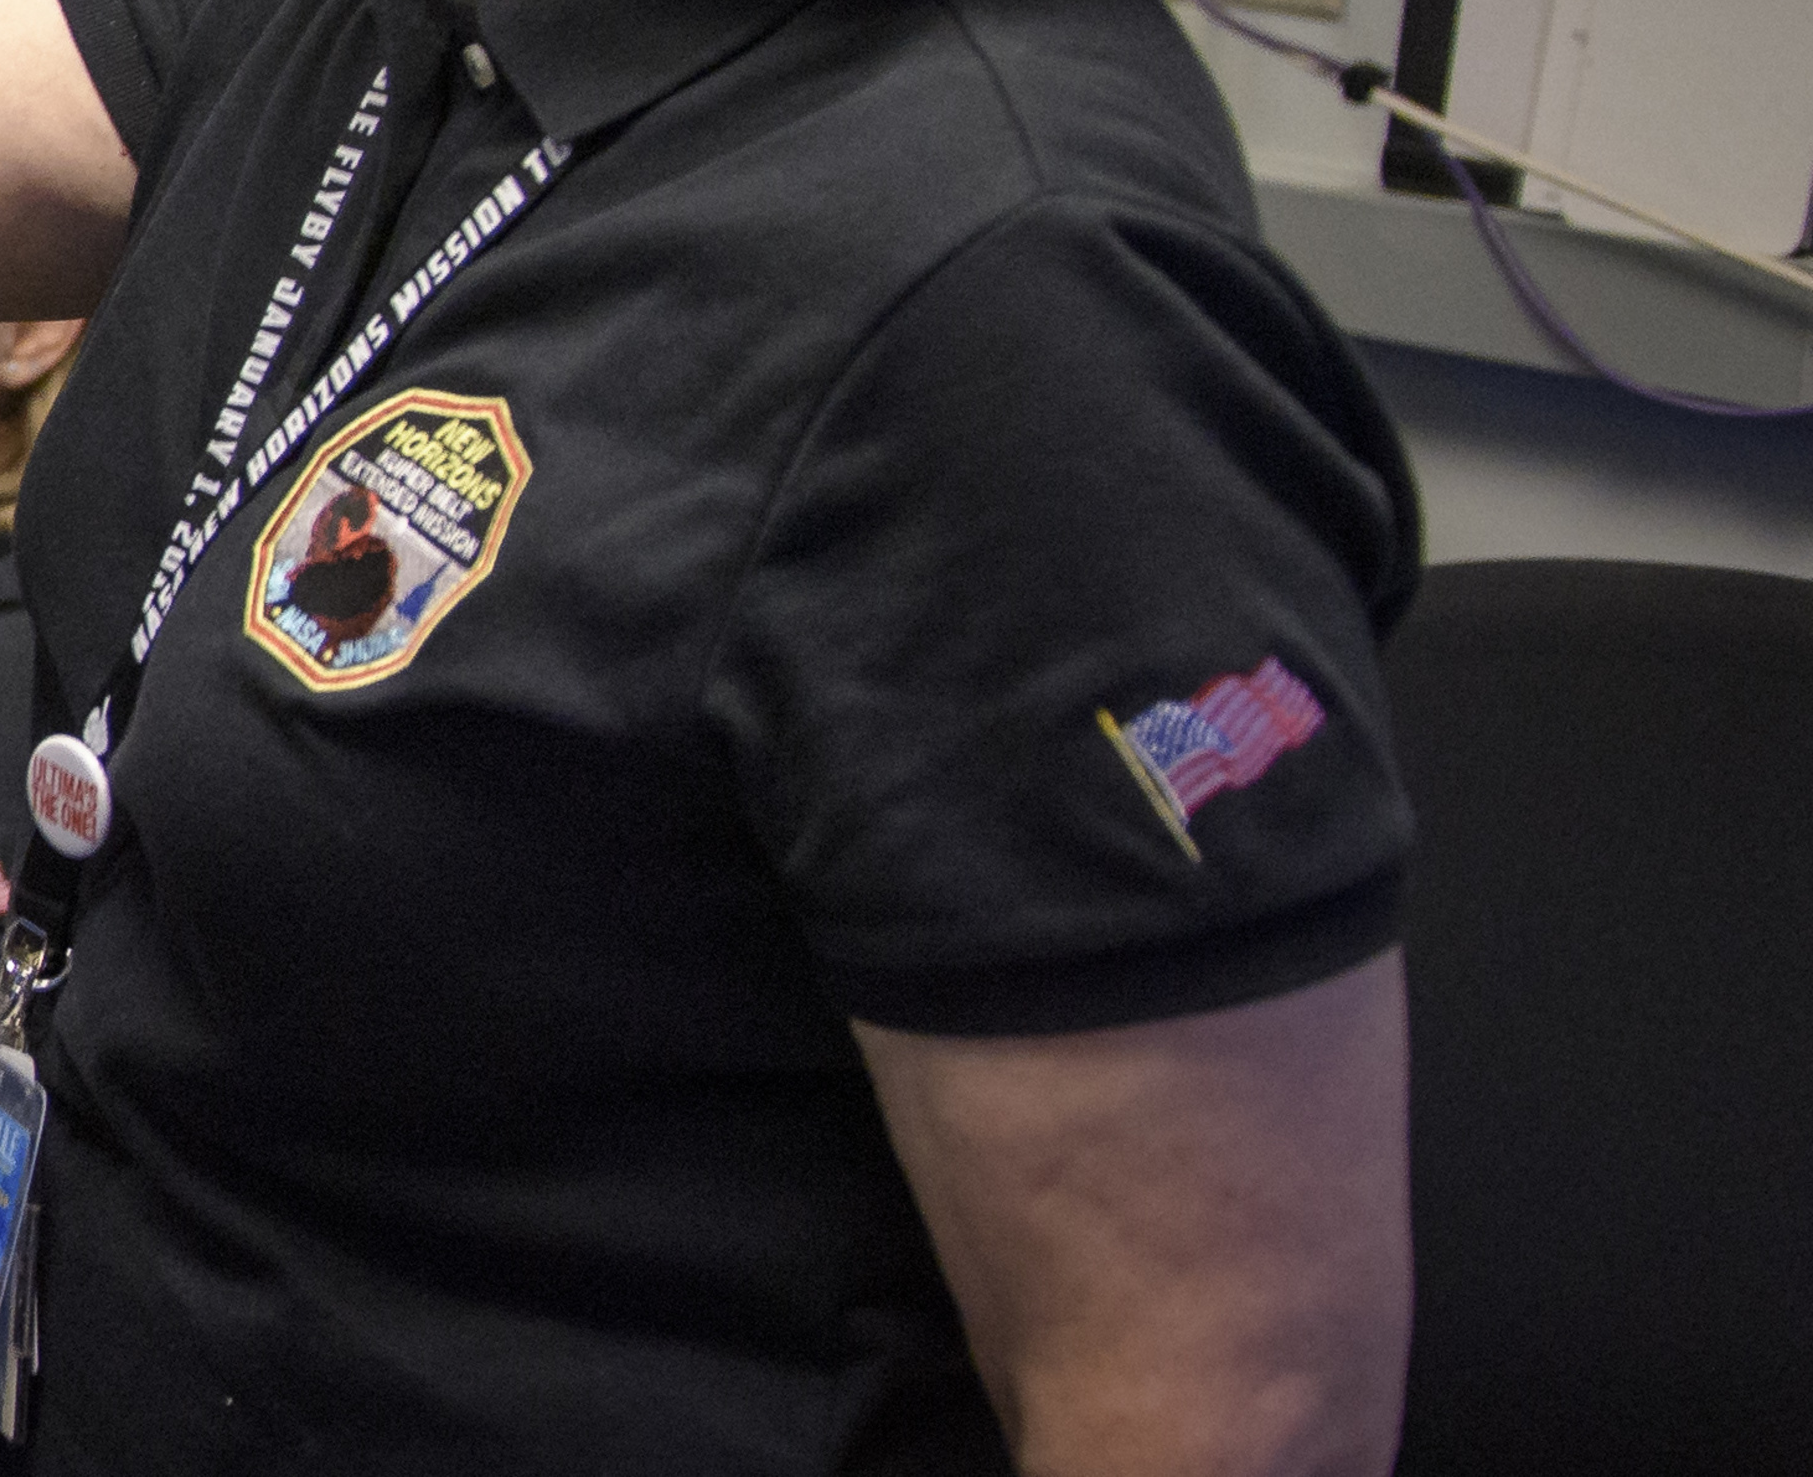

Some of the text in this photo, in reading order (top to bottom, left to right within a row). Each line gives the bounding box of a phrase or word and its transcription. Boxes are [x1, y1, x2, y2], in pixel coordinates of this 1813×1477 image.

[290, 143, 365, 270] FLYBY
[205, 276, 305, 467] JANUARY
[245, 311, 391, 487] HORIZONS
[389, 174, 526, 325] MISSION
[383, 419, 503, 511] HORIZONS
[432, 418, 495, 465] NEW
[338, 448, 480, 562] EXTENDED MISSION
[275, 604, 329, 655] NASA
